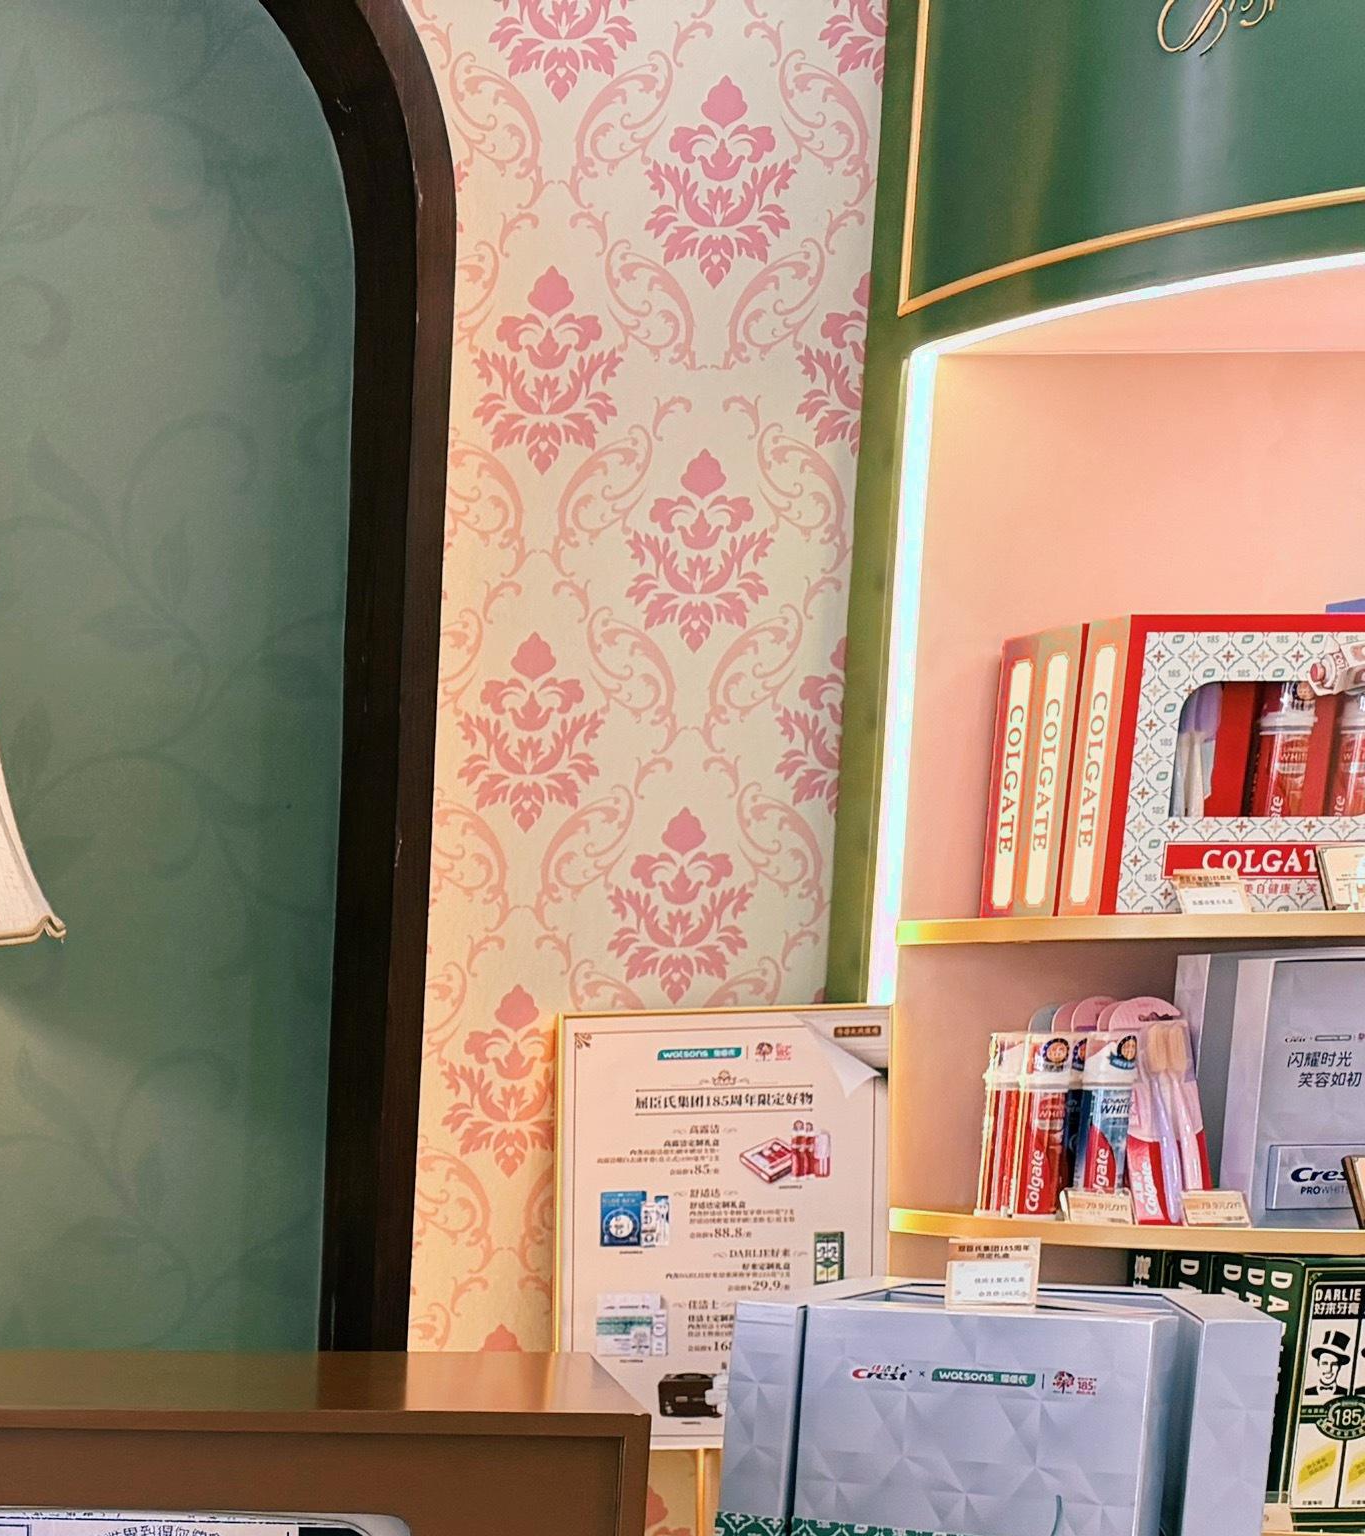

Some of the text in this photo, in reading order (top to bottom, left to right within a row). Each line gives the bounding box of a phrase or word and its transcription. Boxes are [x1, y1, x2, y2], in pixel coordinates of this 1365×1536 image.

[1032, 697, 1062, 852] COLGATE
[1076, 690, 1110, 849] COLGATE
[997, 704, 1026, 856] COLGATE
[1202, 848, 1317, 873] COLGAT
[1287, 1051, 1354, 1068] 闪耀时光
[1297, 1072, 1363, 1088] 笑容如初
[634, 1092, 814, 1111] 屈臣氏集团185周年限定好物
[1025, 1150, 1045, 1211] Colgate
[1290, 1166, 1349, 1184] Cres
[1299, 1184, 1349, 1196] PROWHIT
[1314, 1287, 1362, 1303] DARLIE
[1313, 1302, 1360, 1317] 好来牙膏
[852, 1367, 907, 1382] Crest
[938, 1370, 994, 1384] watsons
[1333, 1407, 1362, 1427] 185
